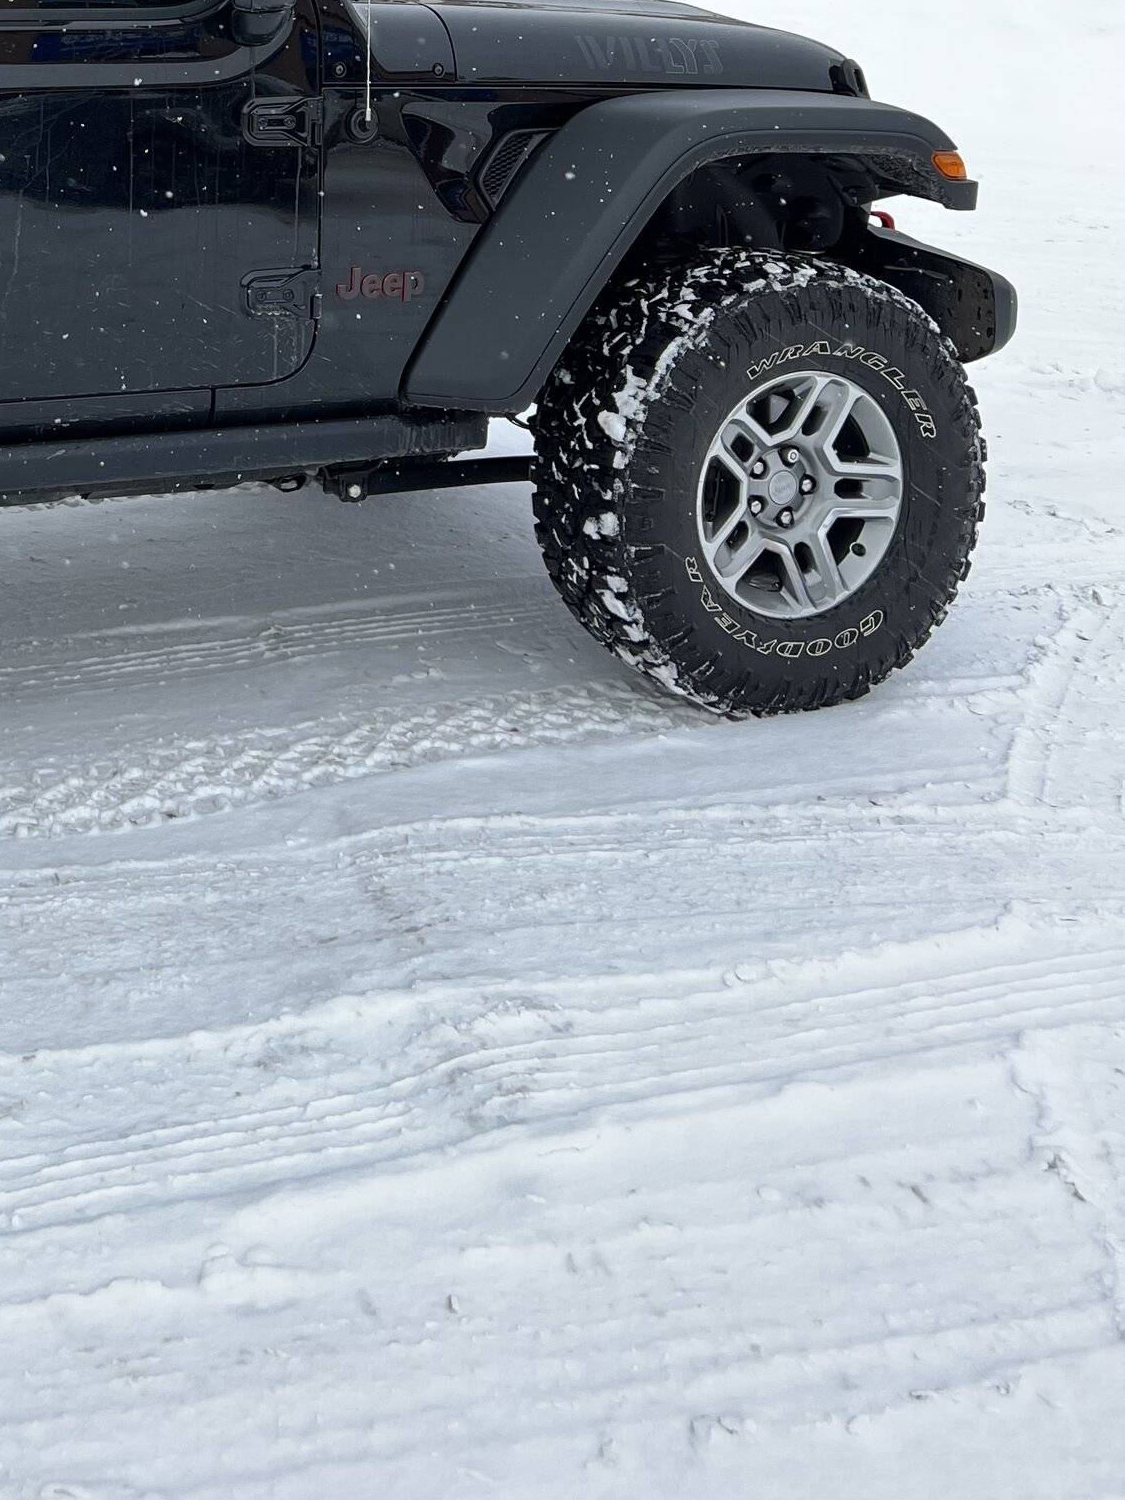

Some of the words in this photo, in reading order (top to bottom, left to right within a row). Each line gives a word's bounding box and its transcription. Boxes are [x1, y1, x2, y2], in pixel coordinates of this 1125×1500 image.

[574, 34, 724, 75] WILLYS
[335, 266, 425, 303] Jeep
[746, 340, 937, 439] WRANGLER
[685, 556, 884, 658] GOODYEAR
